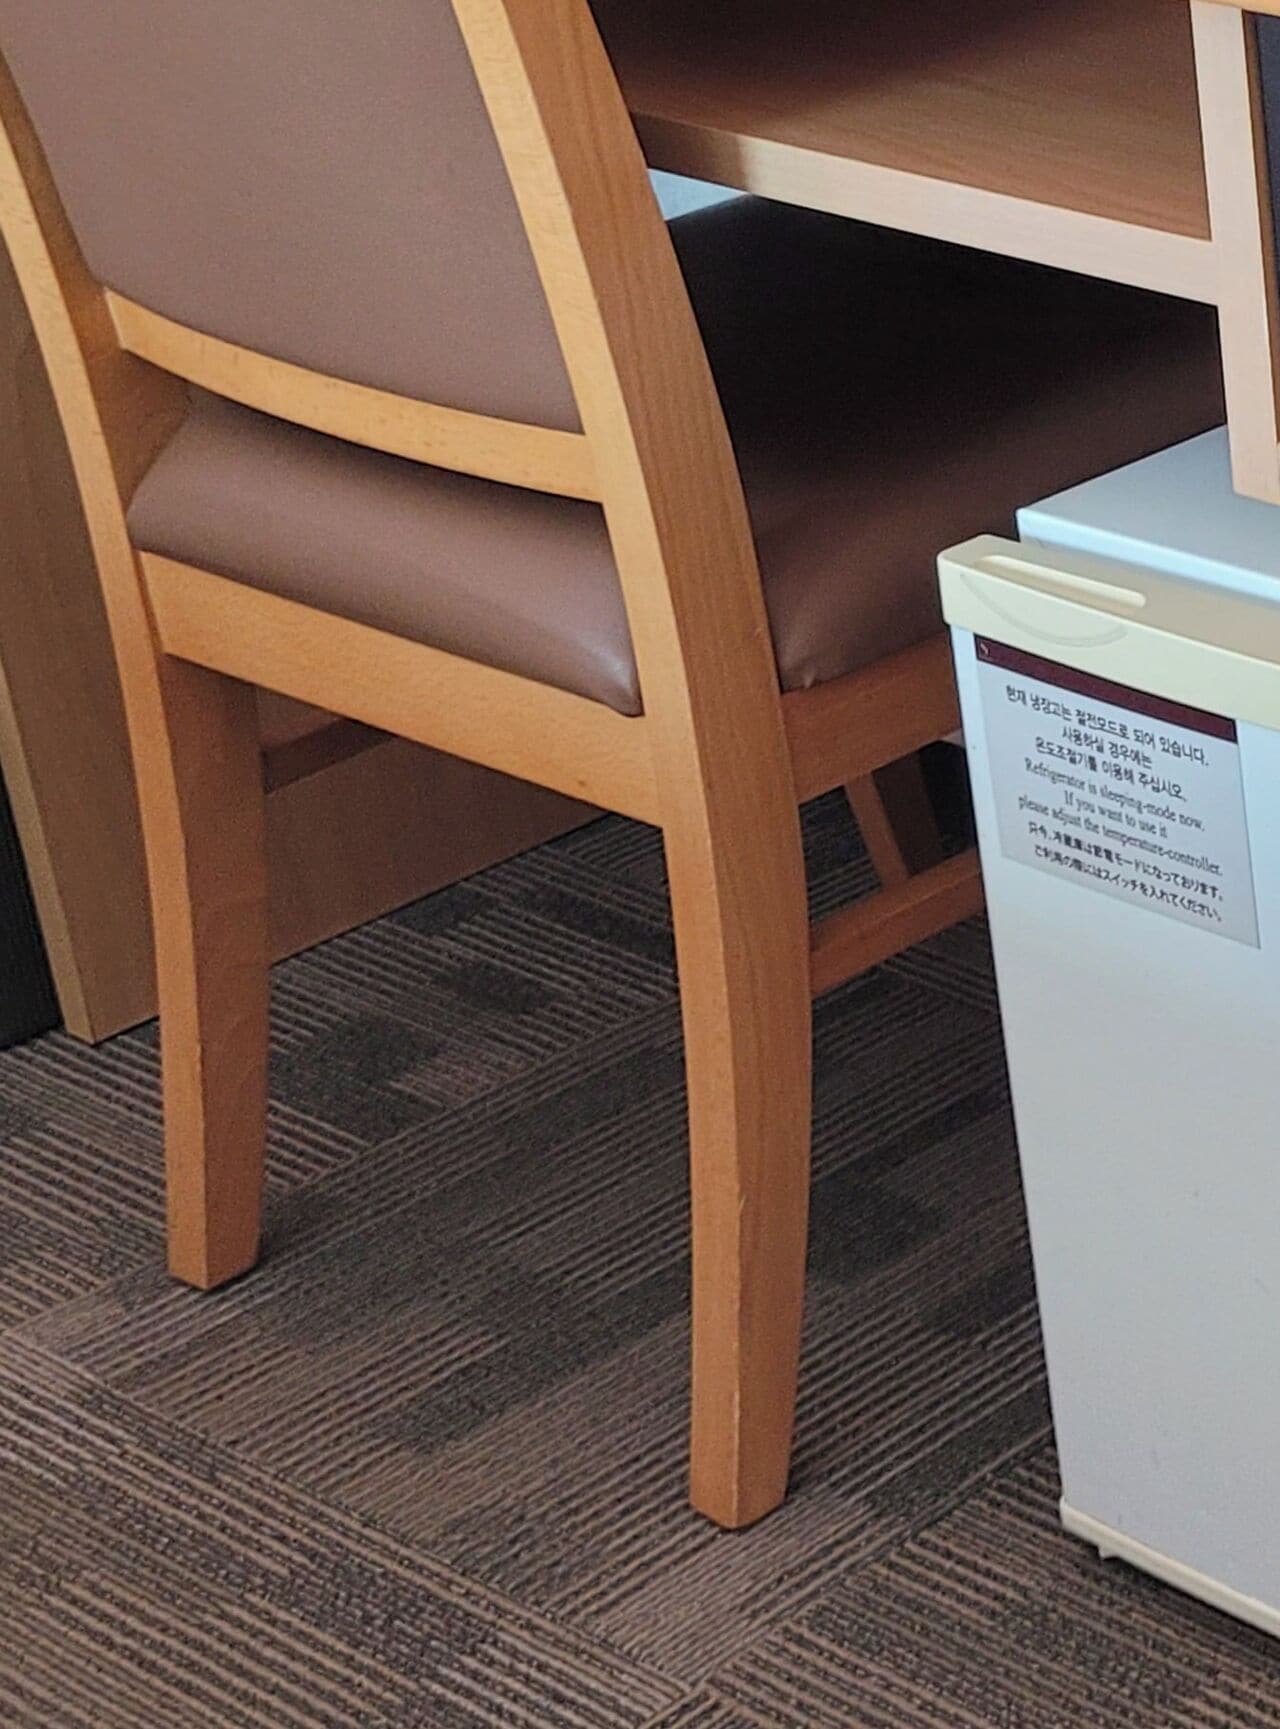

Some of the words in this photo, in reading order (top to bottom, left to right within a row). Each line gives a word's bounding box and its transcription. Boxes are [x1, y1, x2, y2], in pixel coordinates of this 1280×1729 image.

[1006, 684, 1027, 706] 현재
[1030, 693, 1073, 722] 냉장고는
[1076, 709, 1130, 740] 절전모드로
[1133, 728, 1156, 752] 되어
[1159, 736, 1209, 767] 있습니다.
[1062, 726, 1104, 754] 사용하실
[1107, 741, 1153, 770] 경우에는
[1025, 757, 1085, 791] Refrigerator
[1088, 782, 1097, 795] is
[1100, 784, 1176, 822] sleeping-mode
[1102, 760, 1135, 786] 이용해
[1018, 793, 1049, 816] please
[1051, 807, 1082, 828] adjust
[1083, 817, 1100, 835] the
[1064, 789, 1074, 806] If
[1075, 798, 1095, 814] you
[1097, 805, 1123, 824] want
[1125, 814, 1137, 828] to
[1138, 819, 1157, 835] use
